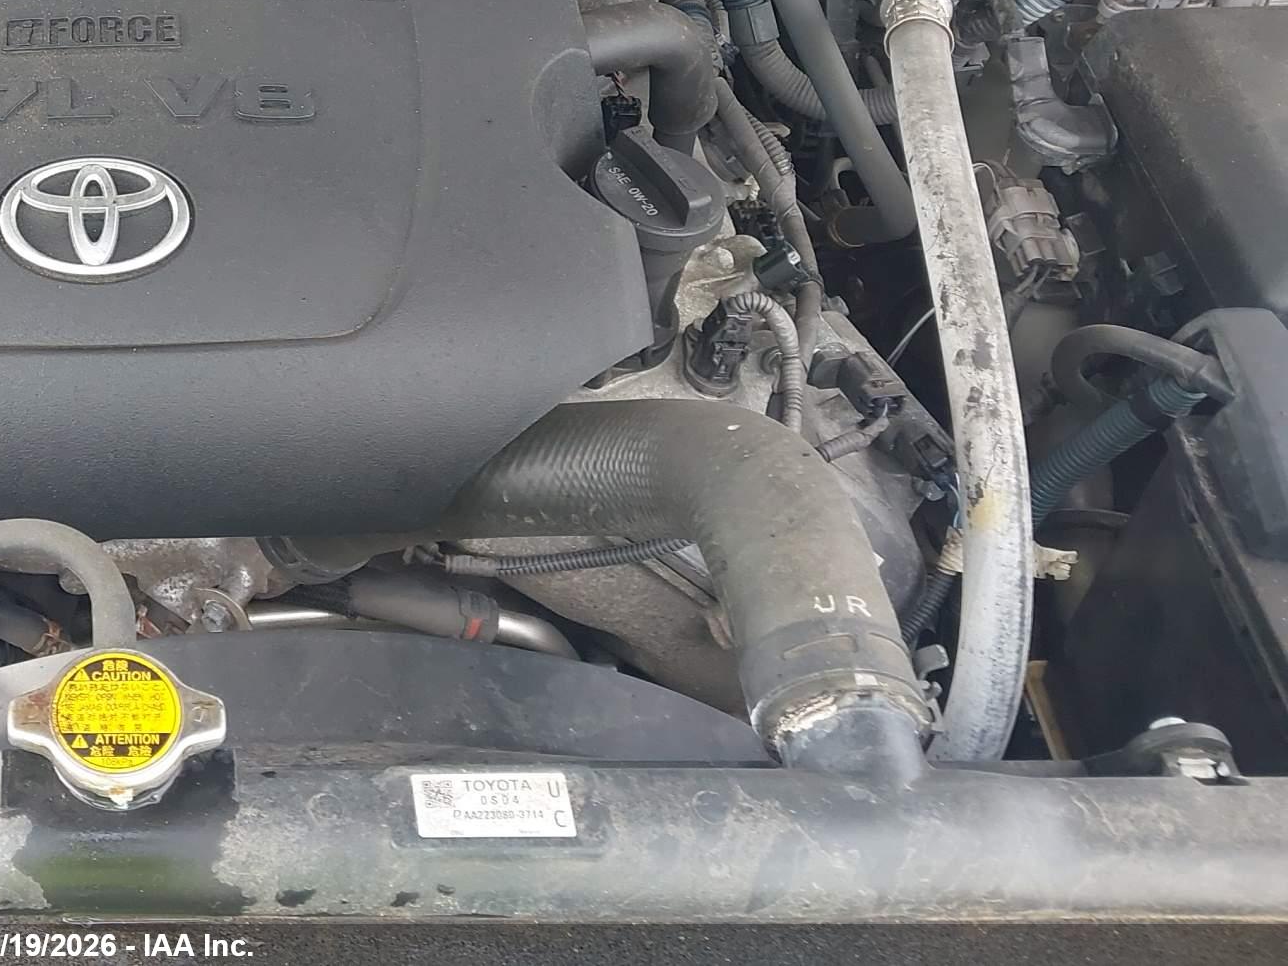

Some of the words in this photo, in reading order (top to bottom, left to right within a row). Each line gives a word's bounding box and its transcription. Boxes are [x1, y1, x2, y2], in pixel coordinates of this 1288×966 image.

[143, 76, 316, 122] V8
[608, 166, 631, 185] SAE
[628, 187, 659, 217] 0W-20
[91, 671, 152, 682] CAUTION
[95, 734, 160, 745] ATTENTION
[464, 780, 532, 791] TOYOTA
[548, 781, 560, 797] U
[554, 811, 567, 827] C
